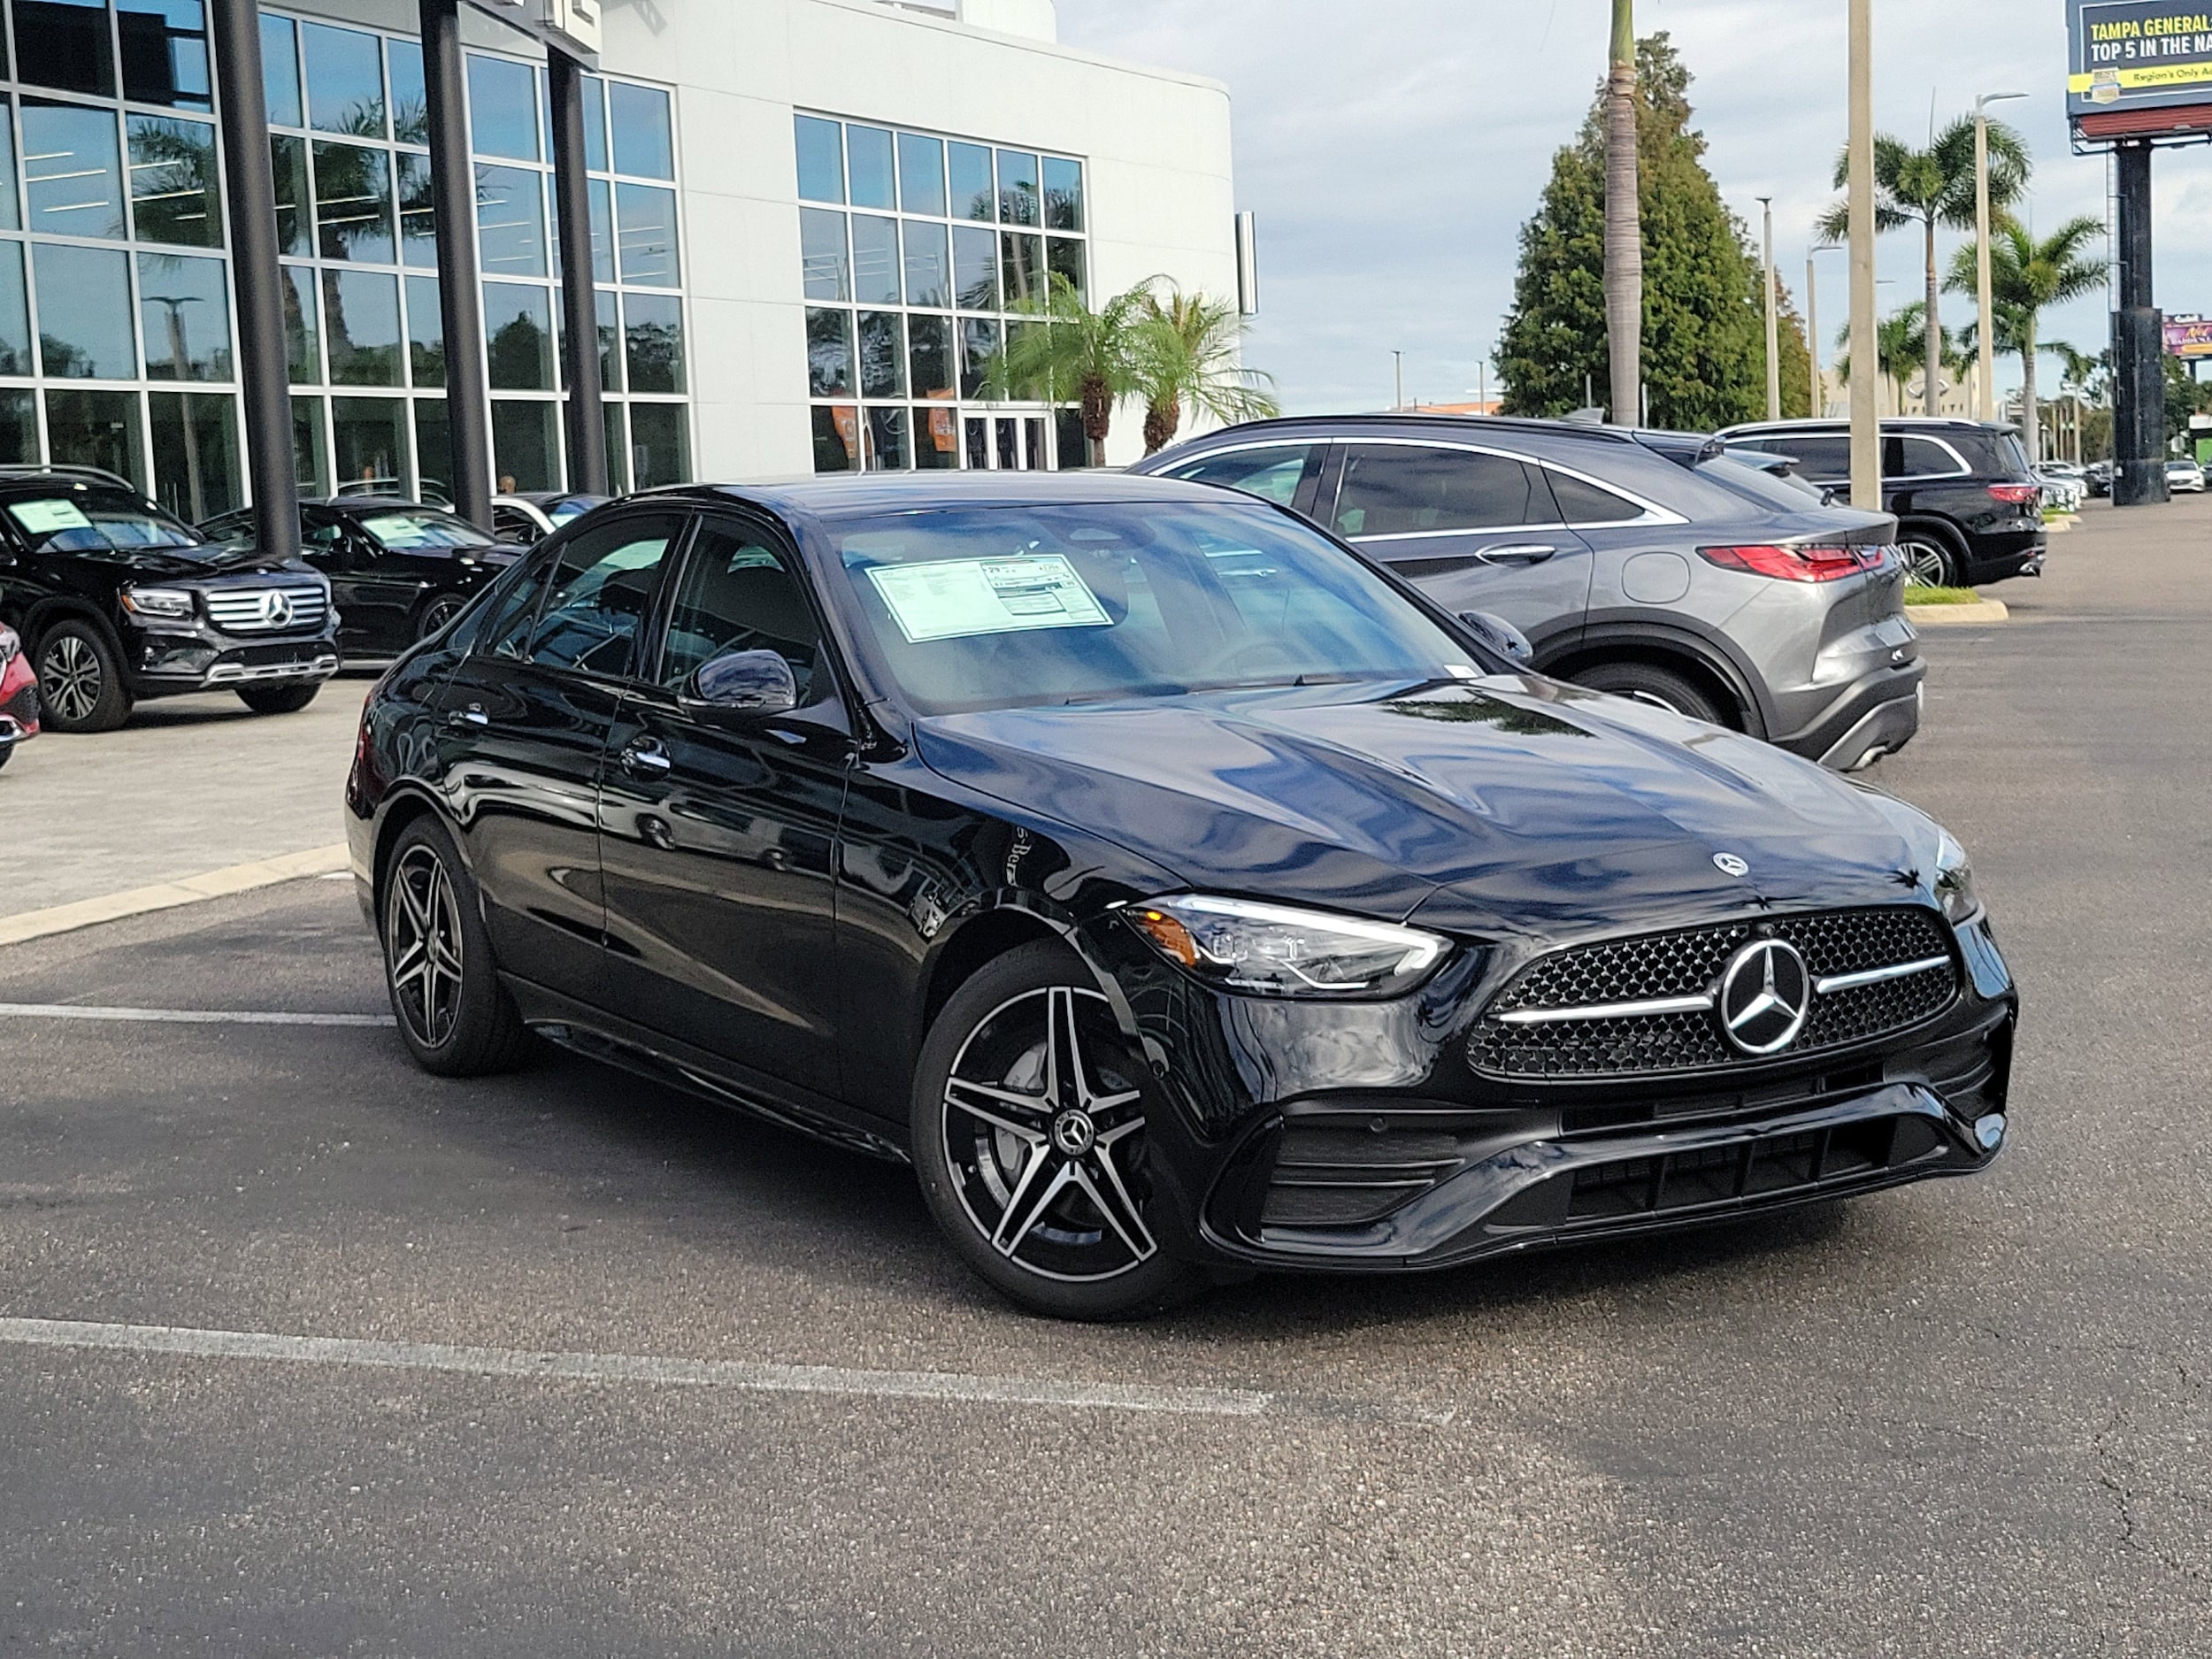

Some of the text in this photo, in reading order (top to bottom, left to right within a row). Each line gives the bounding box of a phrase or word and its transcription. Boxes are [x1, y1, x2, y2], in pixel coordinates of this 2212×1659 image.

[2091, 14, 2211, 41] TAMPA GENERAL
[2091, 42, 2121, 61] TOP
[2125, 41, 2136, 58] 5
[2139, 38, 2157, 57] IN
[2161, 35, 2191, 55] THE
